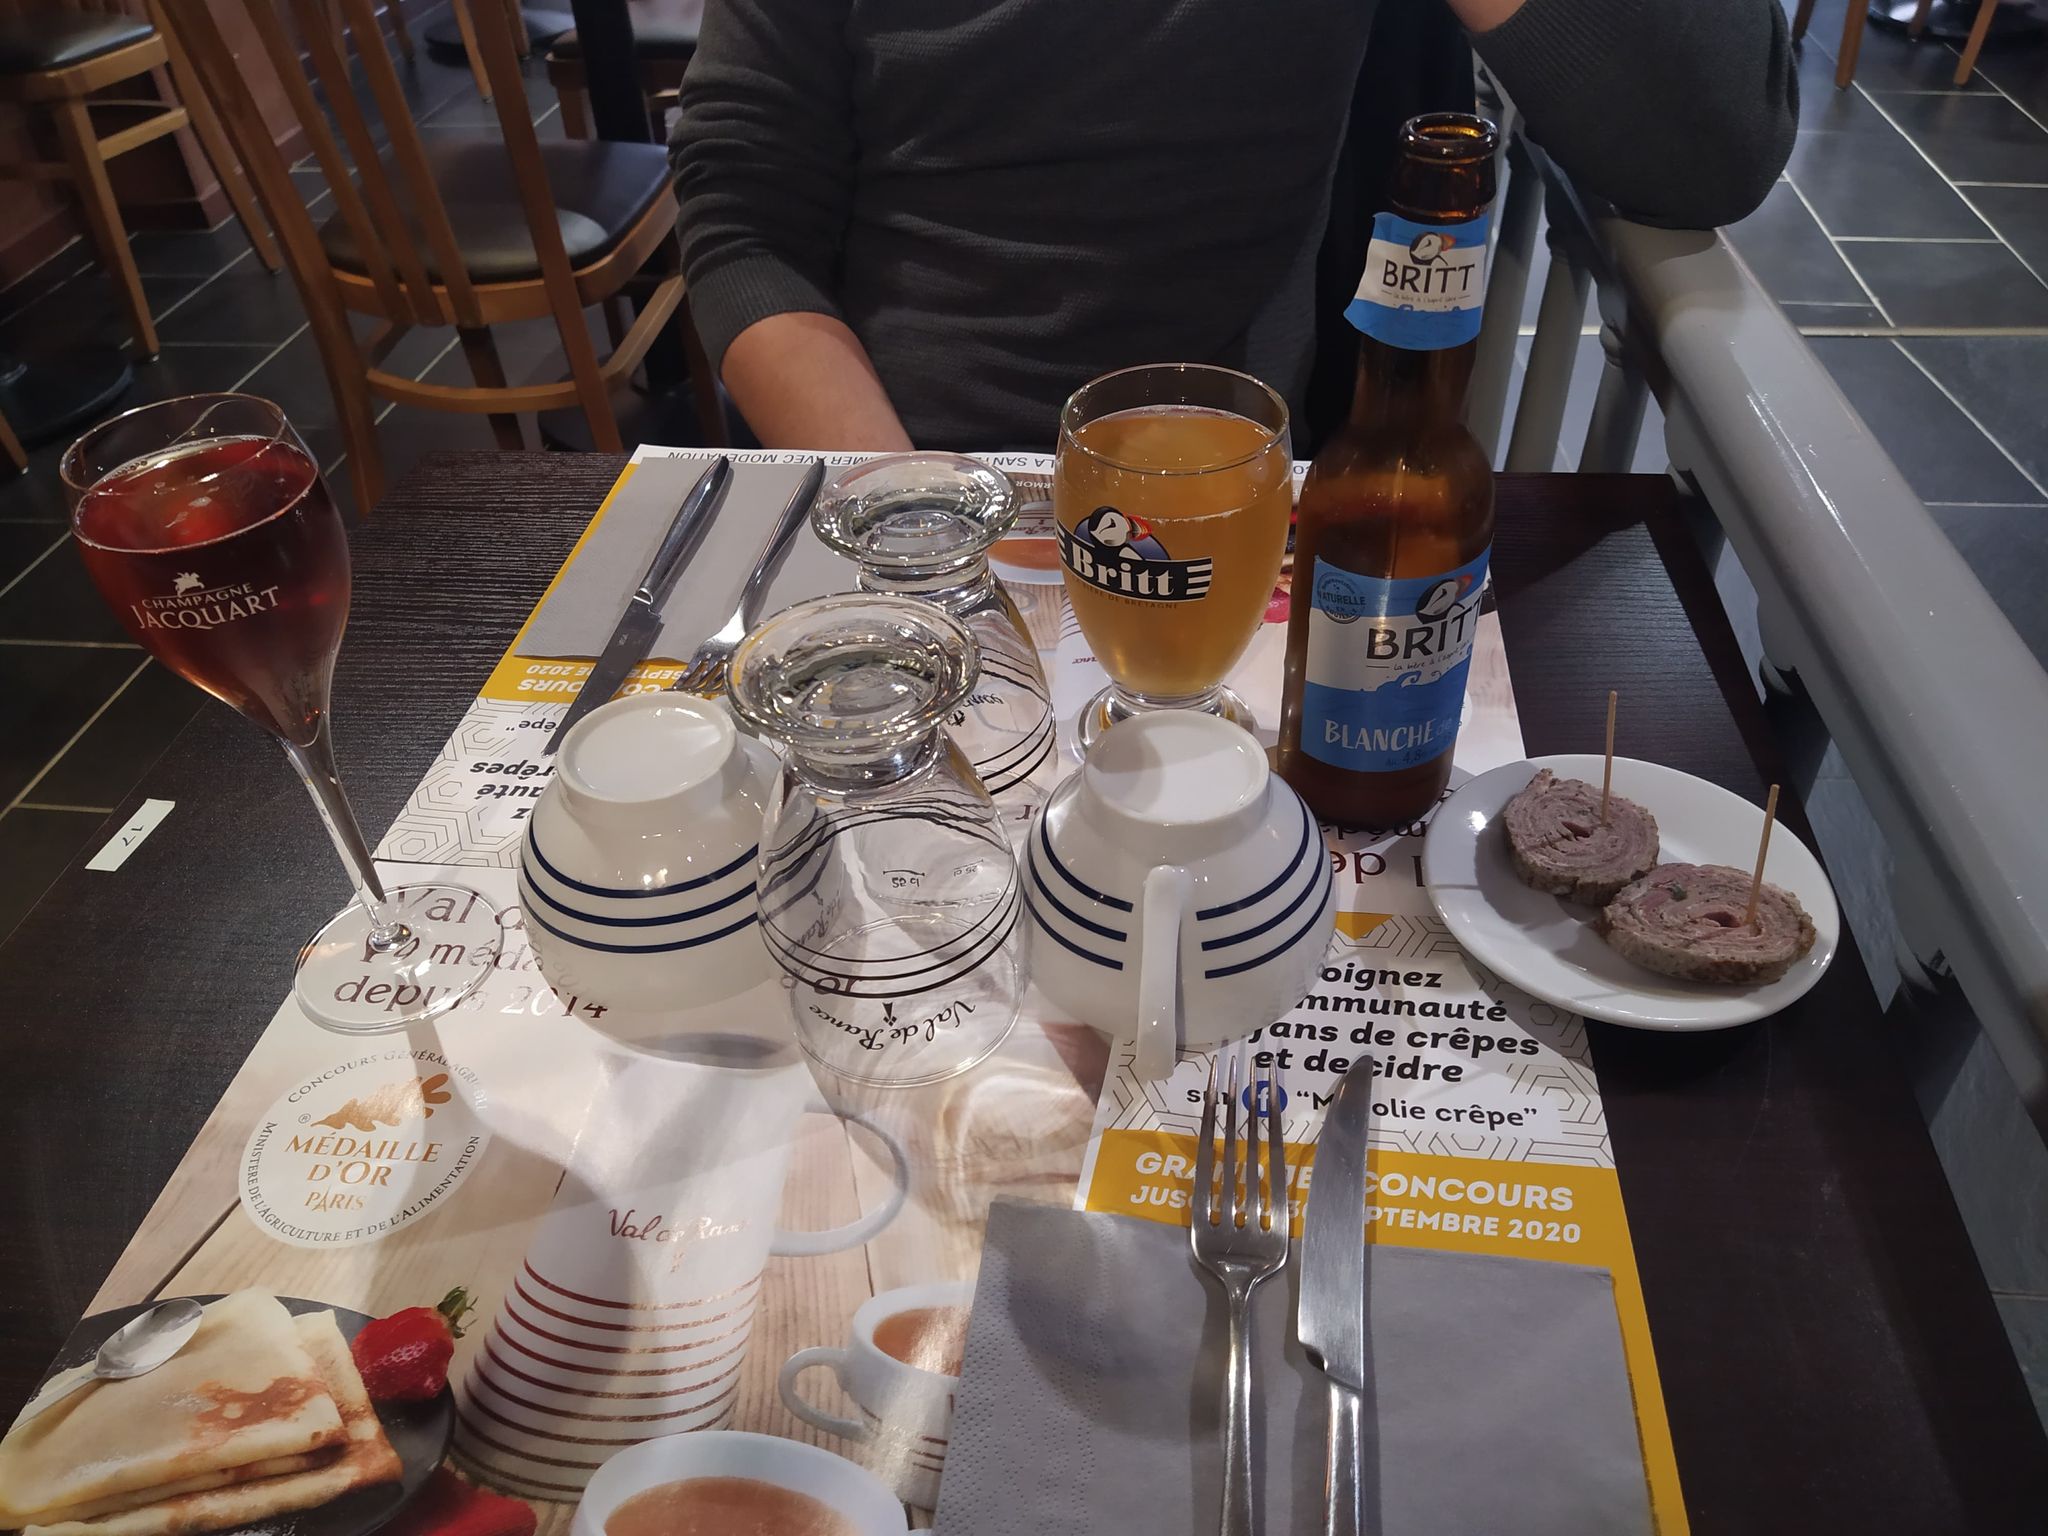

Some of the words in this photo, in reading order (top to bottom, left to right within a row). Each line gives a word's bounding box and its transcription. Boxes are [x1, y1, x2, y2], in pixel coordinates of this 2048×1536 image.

[1382, 259, 1475, 293] BRITT
[667, 451, 778, 463] MODEATION
[1035, 458, 1055, 468] LA
[1016, 480, 1055, 489] RMOR
[1071, 541, 1175, 596] Britt
[130, 585, 279, 629] JACQUART
[141, 582, 254, 609] CHAMPAGNE
[526, 664, 575, 676] 2020
[1324, 719, 1436, 752] BLANCHE
[470, 759, 556, 780] rêpes
[398, 886, 480, 924] Val
[1320, 962, 1444, 992] oignez
[499, 985, 609, 1020] 2014
[809, 1004, 885, 1050] Rance
[890, 1026, 919, 1045] de
[924, 1001, 976, 1042] Val
[1350, 1021, 1396, 1046] de
[1406, 1028, 1540, 1059] crêpes
[288, 1054, 378, 1104] CONCOURS
[1255, 1048, 1293, 1069] et
[1303, 1049, 1349, 1075] de
[1372, 1054, 1464, 1083] cidre
[1371, 1098, 1426, 1120] olie
[1435, 1104, 1538, 1132] crêpe”
[247, 1121, 278, 1187] MINISTERE
[284, 1131, 443, 1163] MÉDAILLE
[306, 1160, 392, 1187] D'OR
[248, 1185, 262, 1203] DE
[303, 1185, 367, 1213] PARIS
[1364, 1172, 1574, 1212] CONCOURS
[344, 1227, 364, 1241] ET
[366, 1219, 388, 1236] DE
[608, 1208, 662, 1241] Val
[1363, 1205, 1500, 1237] PTEMBRE
[1507, 1218, 1582, 1244] 2020
